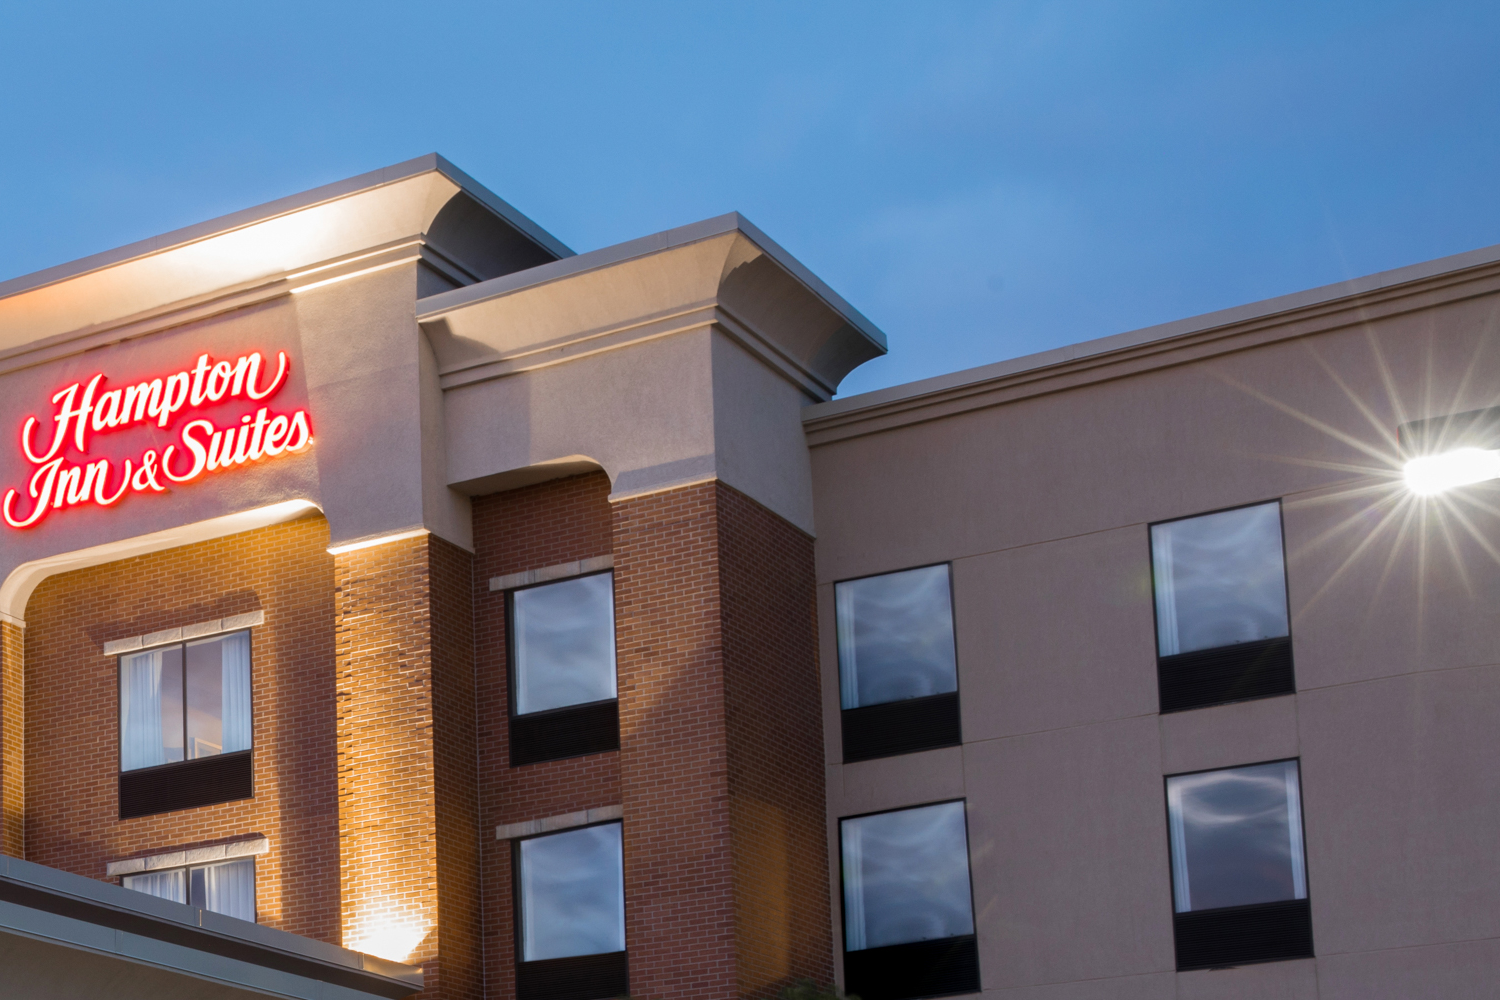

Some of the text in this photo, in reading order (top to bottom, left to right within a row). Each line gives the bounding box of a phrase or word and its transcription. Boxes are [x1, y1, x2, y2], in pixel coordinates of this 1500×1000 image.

[21, 350, 288, 464] Hampton
[2, 407, 311, 528] Inn & Suites
